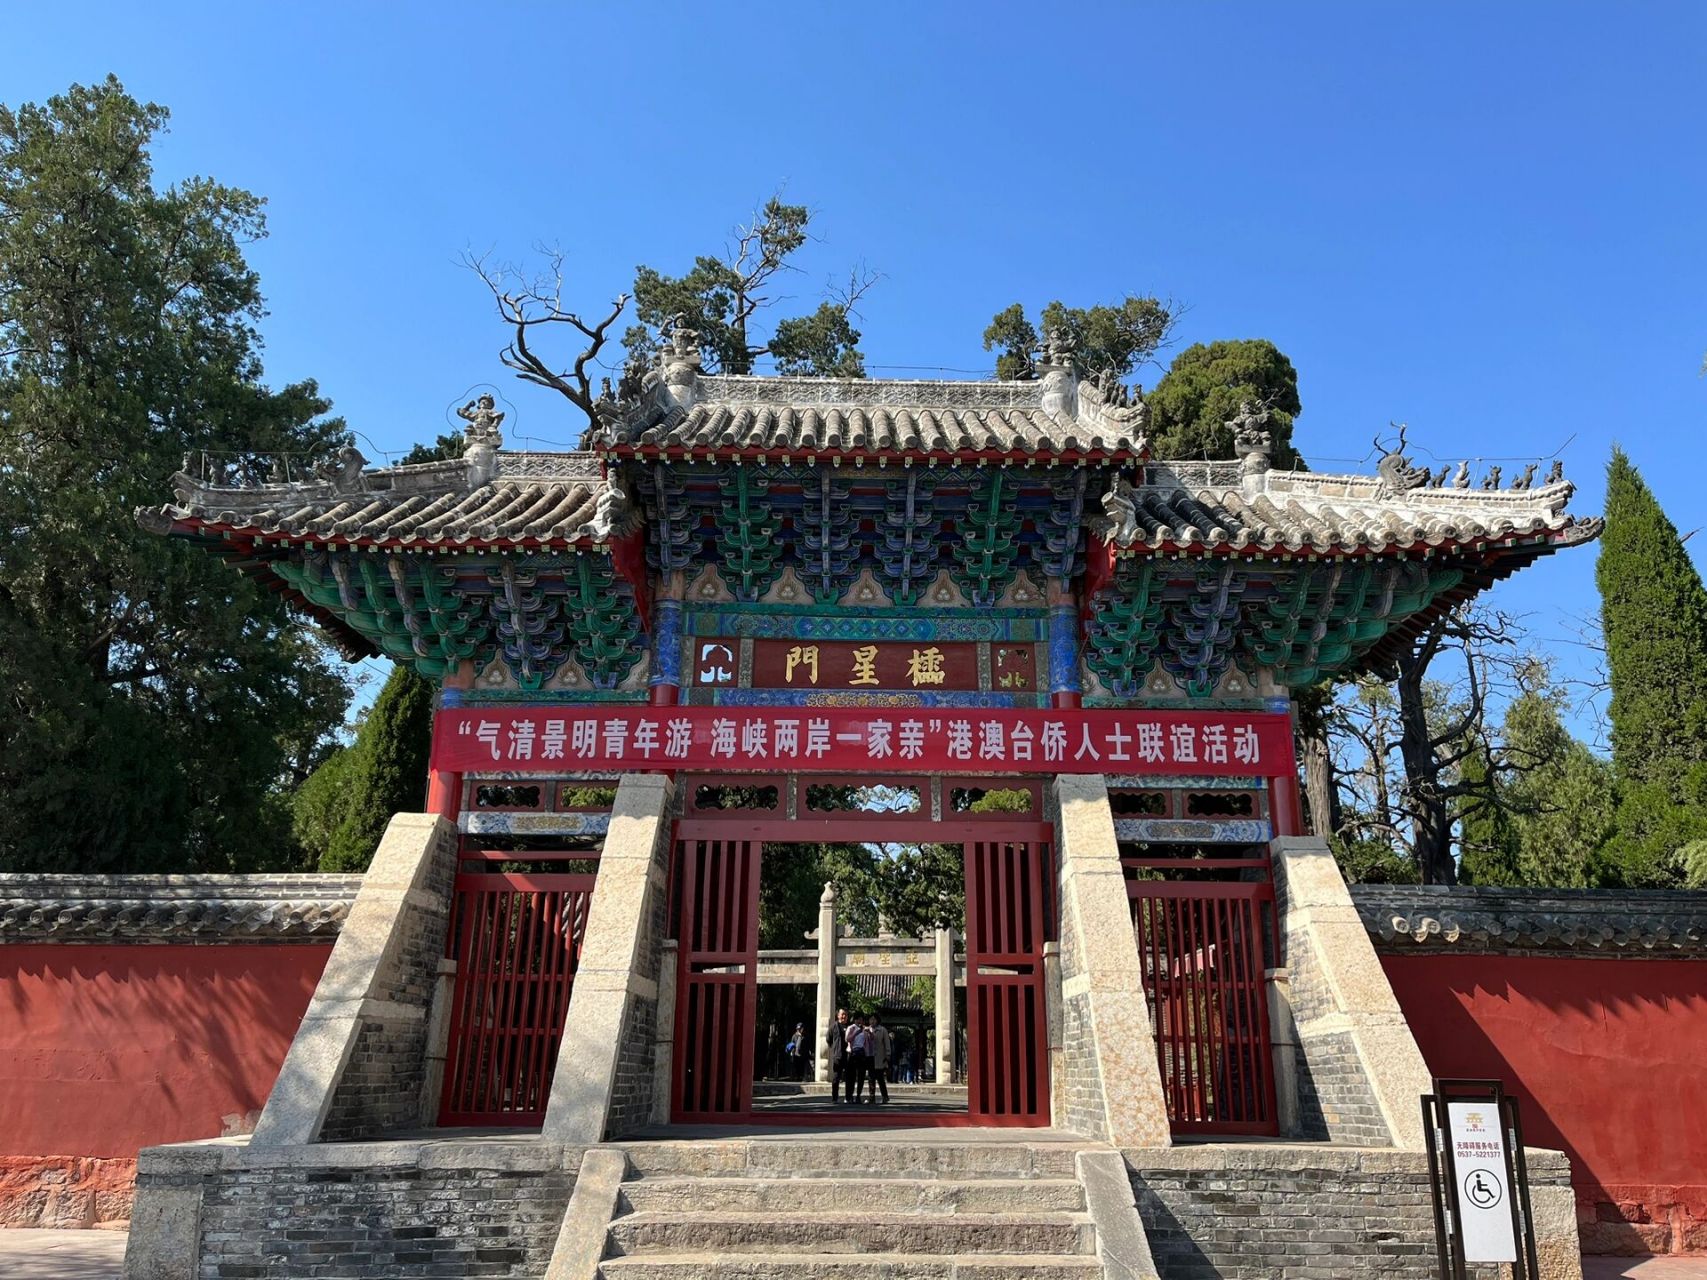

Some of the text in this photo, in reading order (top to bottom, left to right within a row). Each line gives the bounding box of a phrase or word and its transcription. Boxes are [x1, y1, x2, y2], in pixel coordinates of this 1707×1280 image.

[458, 718, 693, 760] “气清景明青年游
